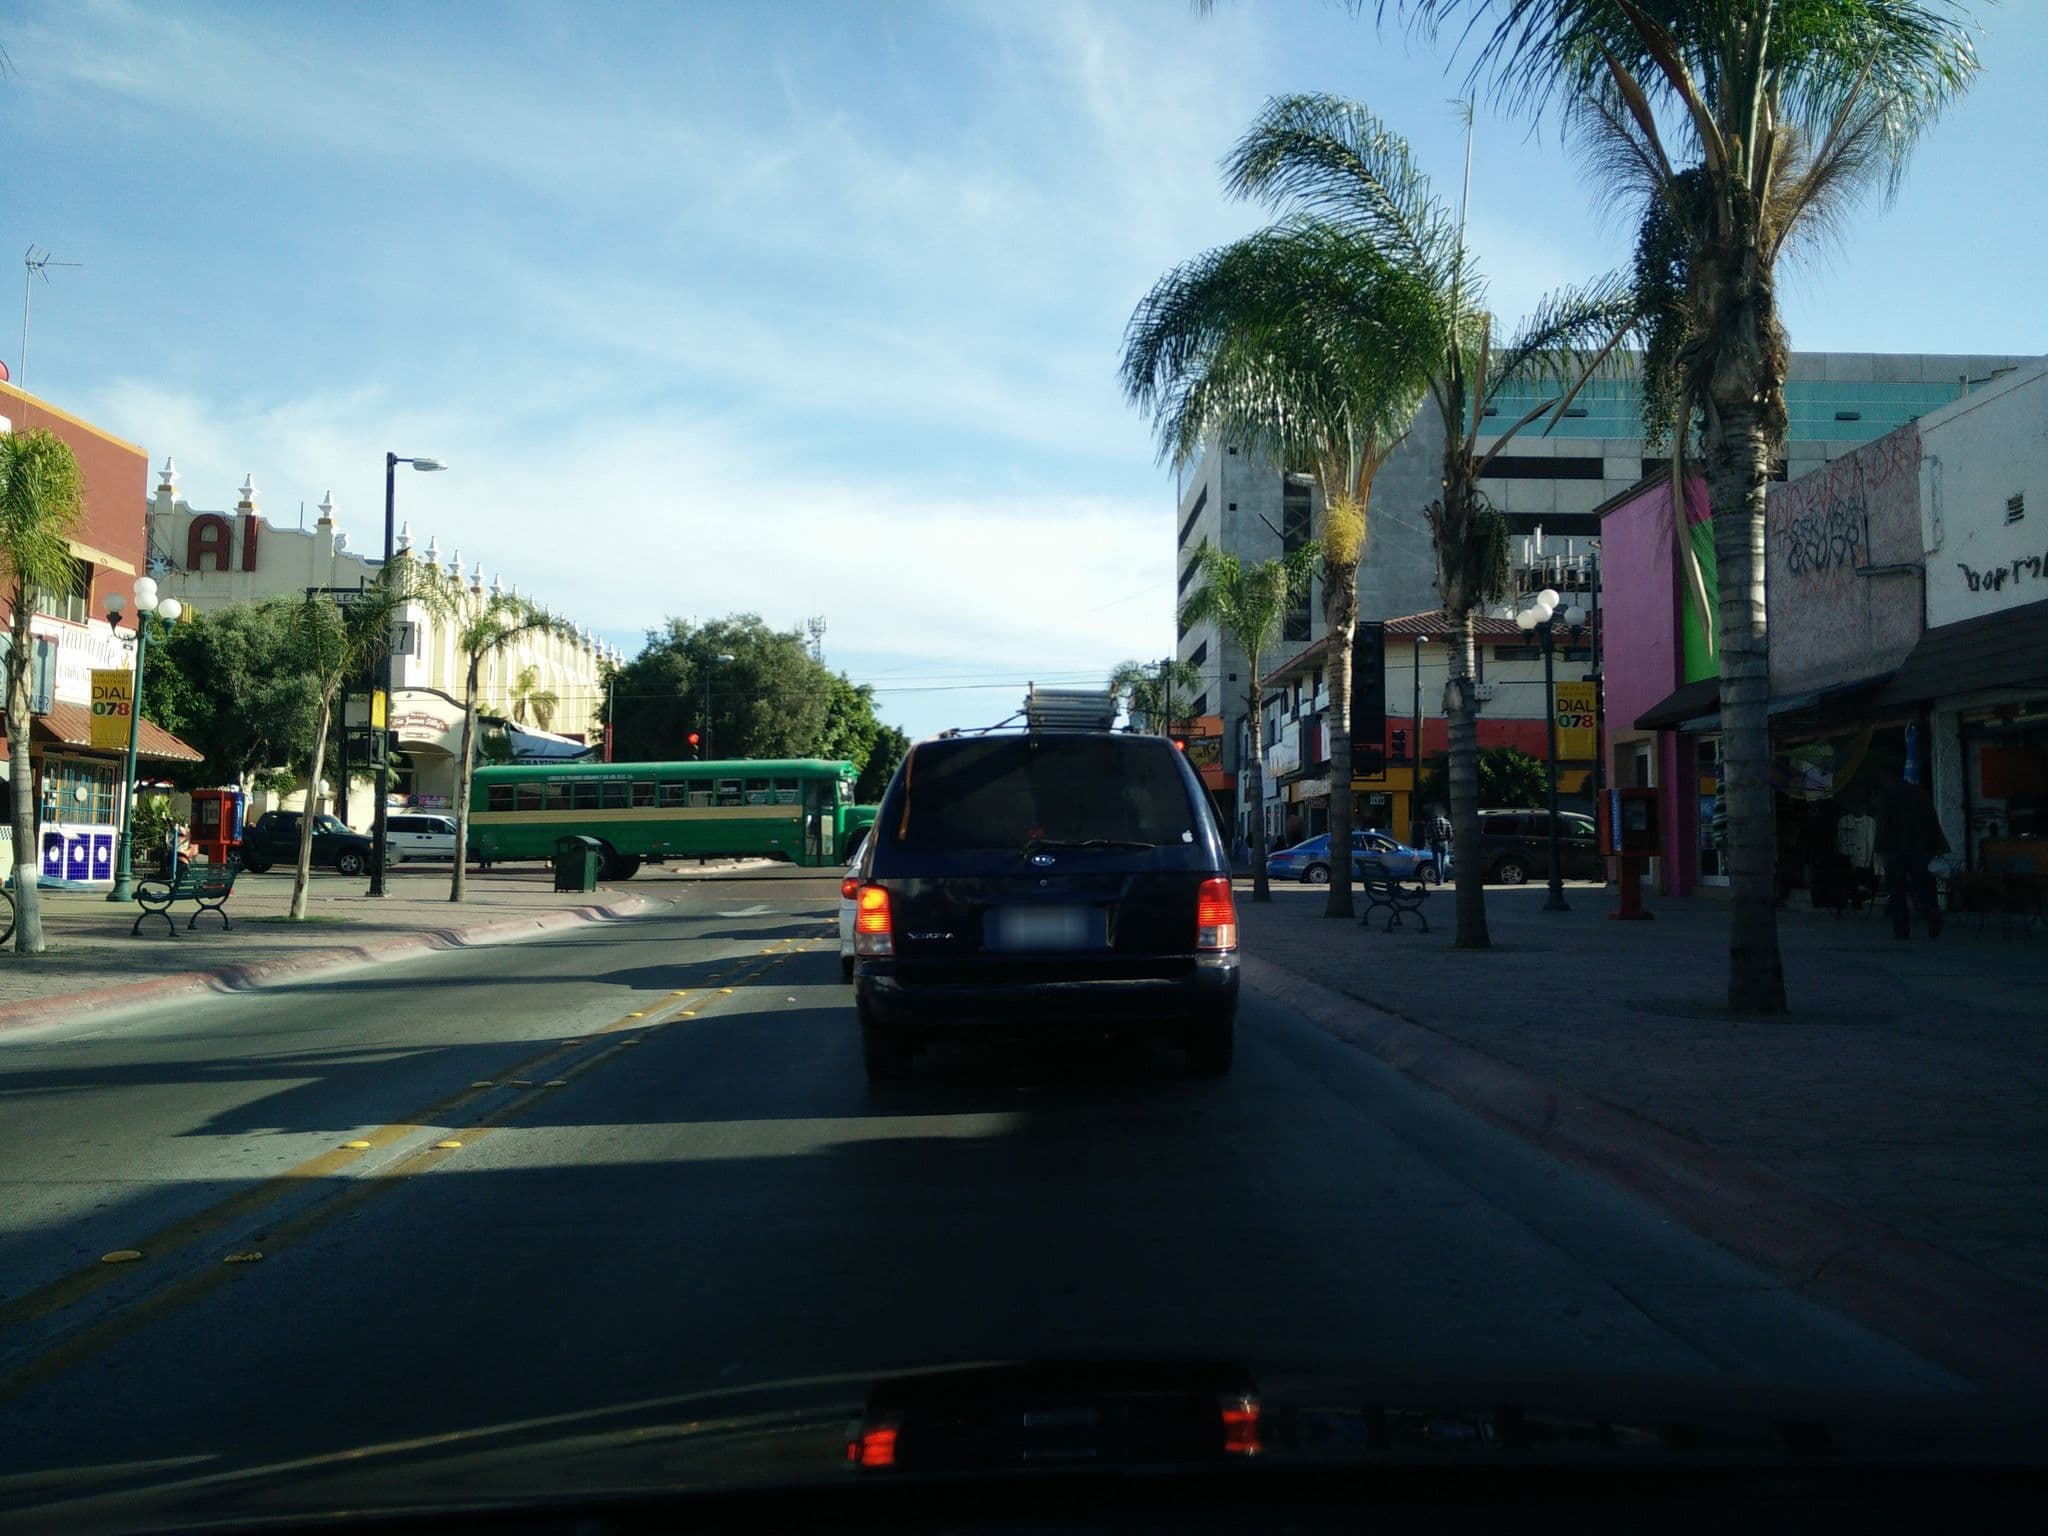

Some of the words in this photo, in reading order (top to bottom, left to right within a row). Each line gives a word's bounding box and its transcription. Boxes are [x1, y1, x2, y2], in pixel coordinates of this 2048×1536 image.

[92, 686, 132, 700] DIAL
[92, 701, 130, 716] 078
[1557, 699, 1596, 712] DIAL
[1558, 714, 1594, 728] 078
